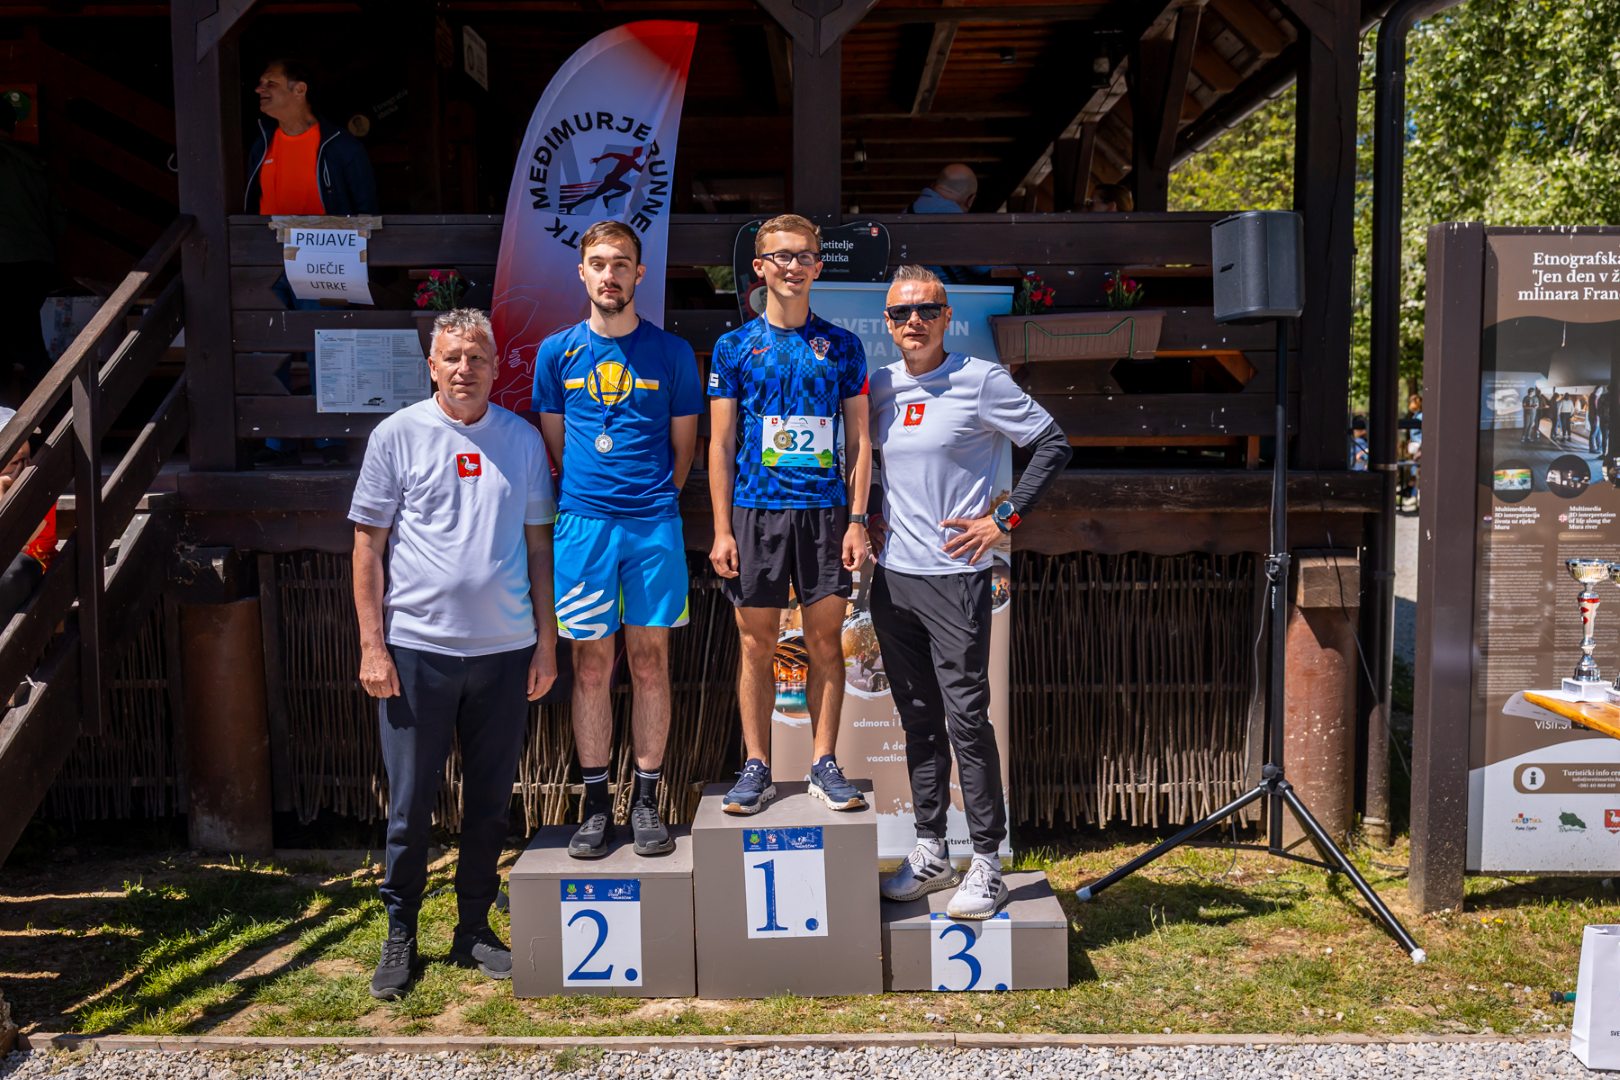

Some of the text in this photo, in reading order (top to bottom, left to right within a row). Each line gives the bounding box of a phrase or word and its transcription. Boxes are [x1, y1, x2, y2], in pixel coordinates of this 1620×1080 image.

[529, 112, 653, 210] MEĐIMURJE
[296, 232, 357, 247] PRIJAVE
[821, 252, 849, 263] zbirka
[306, 261, 345, 275] DJEČJE
[1566, 269, 1596, 283] den
[1599, 273, 1609, 283] v
[310, 280, 348, 292] UTRKE
[1518, 287, 1620, 301] mlinara Fran
[853, 717, 890, 728] odmora
[883, 741, 890, 751] A
[1562, 768, 1595, 777] Turistički
[1595, 768, 1610, 777] info
[753, 858, 820, 932] 1.
[567, 908, 639, 982] 2.
[937, 923, 1009, 992] 3.
